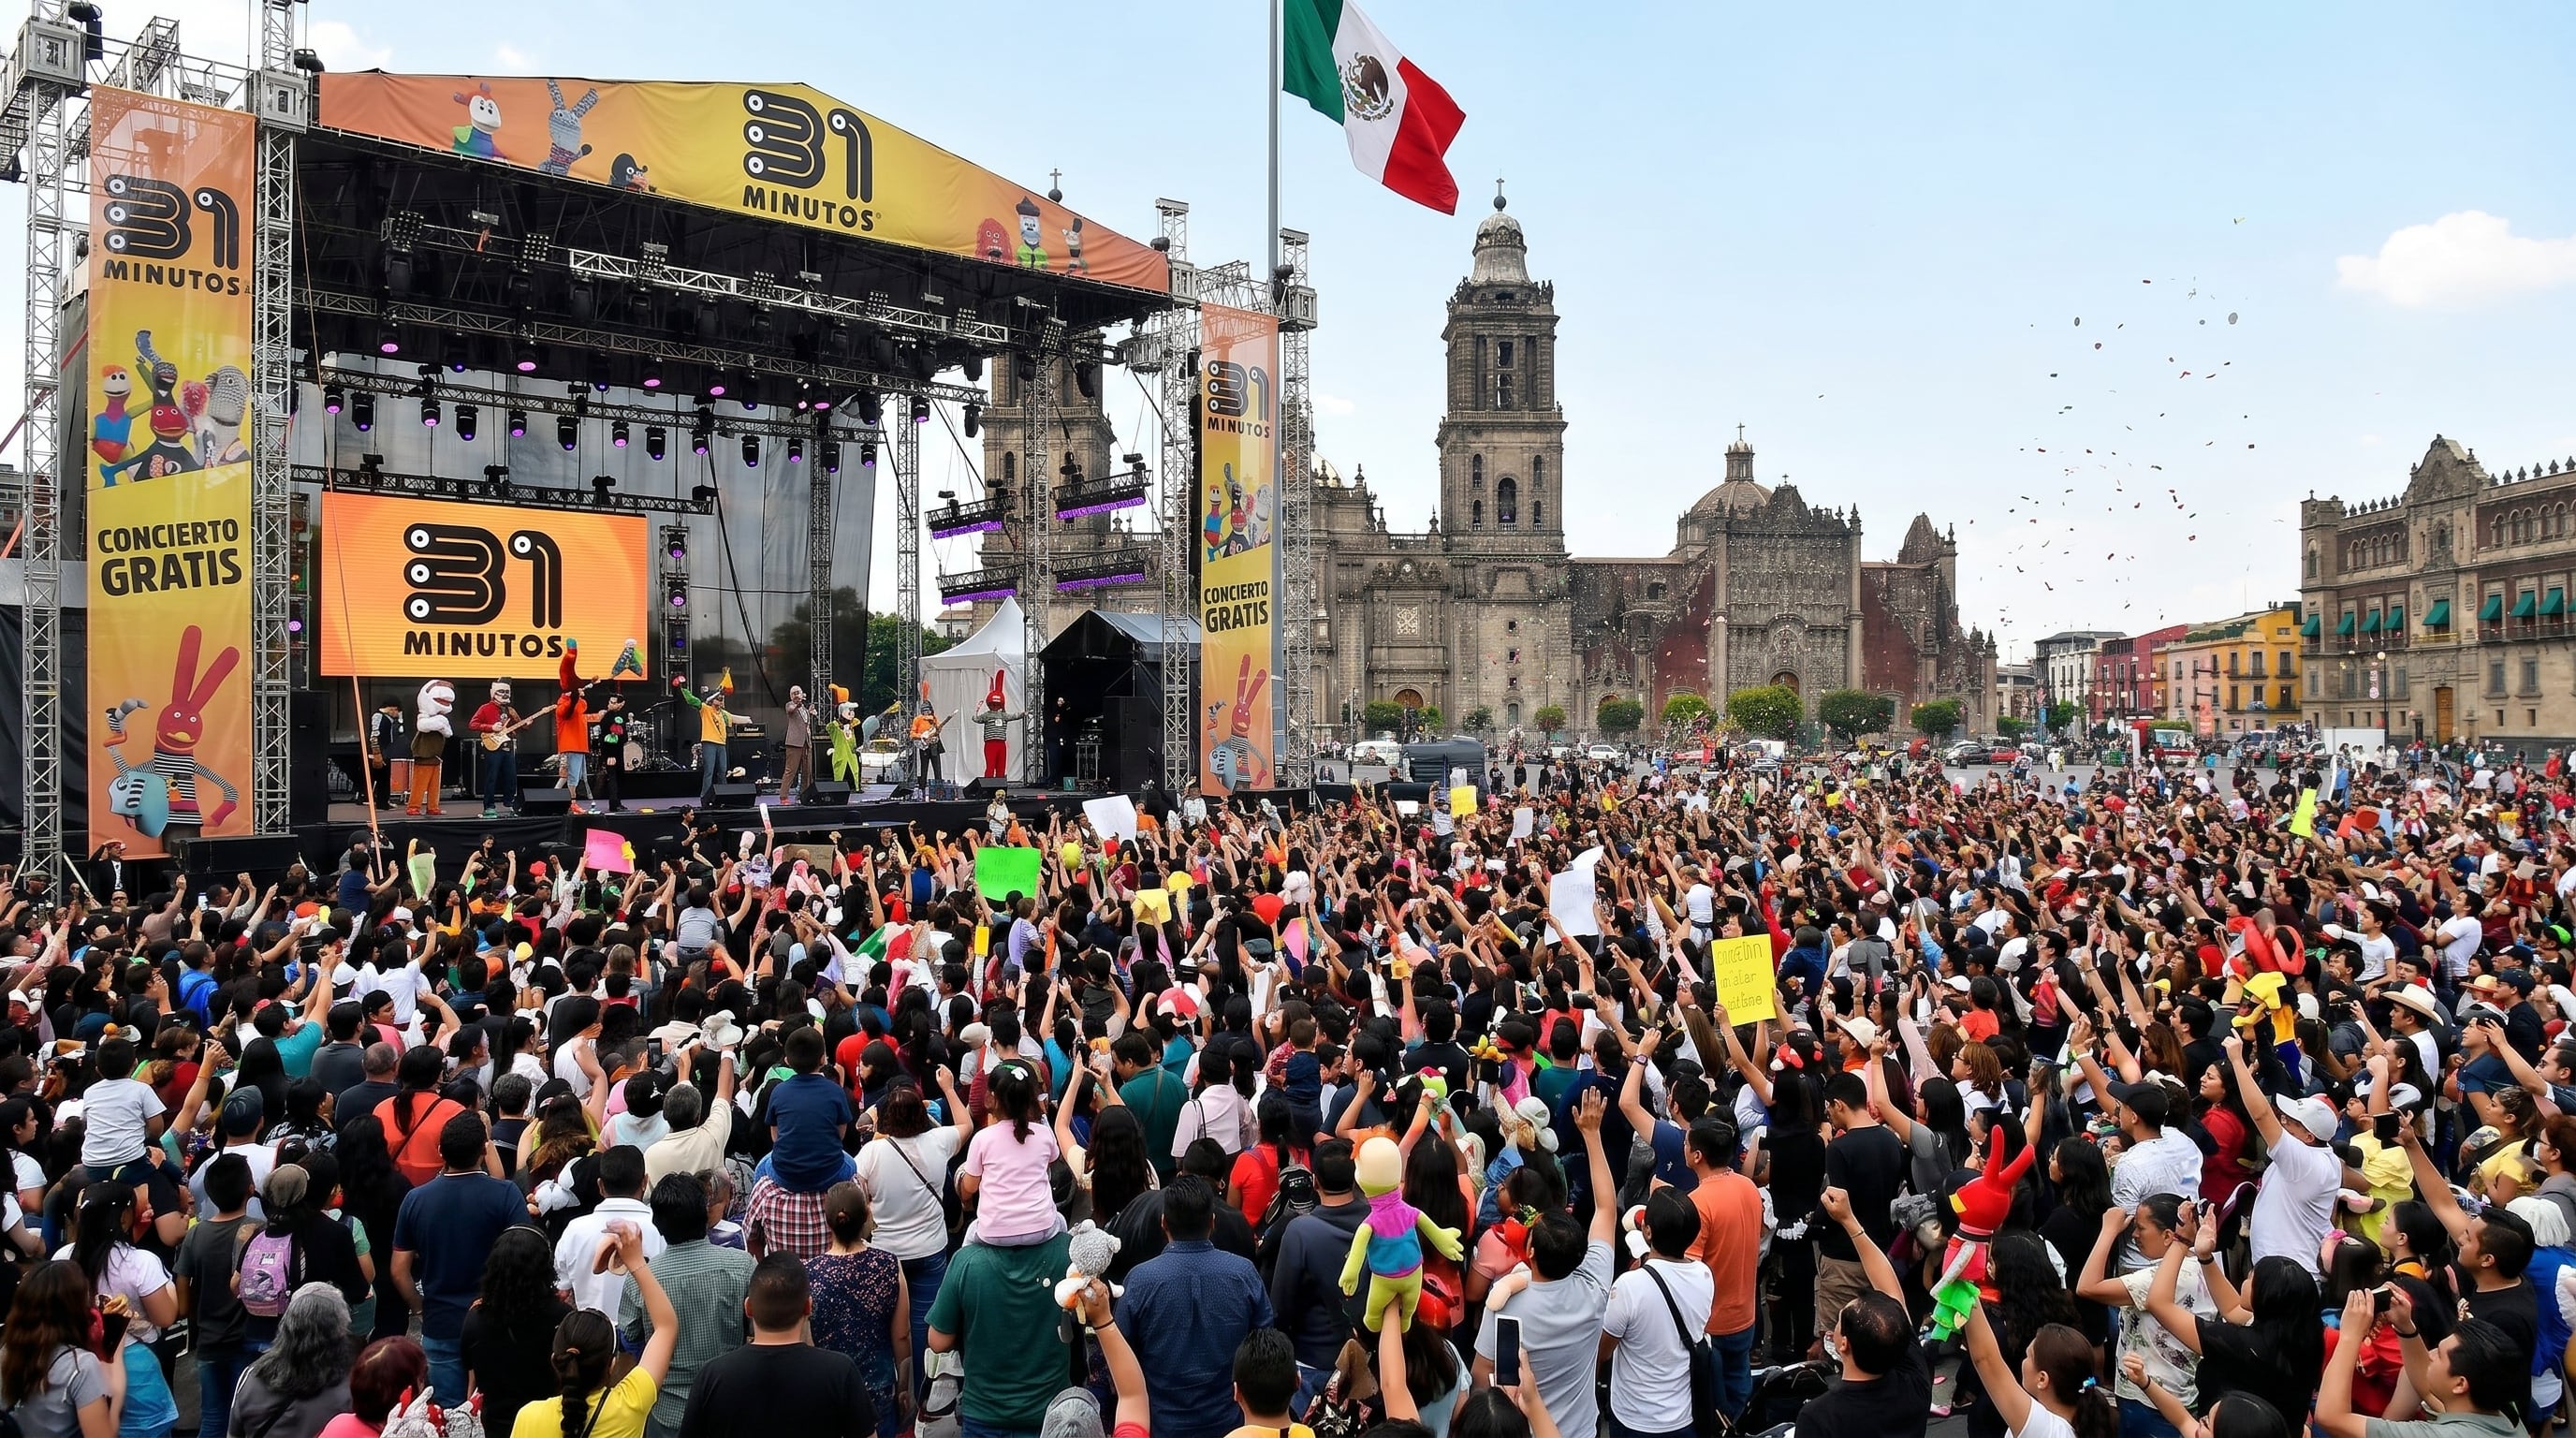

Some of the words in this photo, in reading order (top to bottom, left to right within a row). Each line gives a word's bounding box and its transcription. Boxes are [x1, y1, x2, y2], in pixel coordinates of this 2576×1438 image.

[743, 89, 873, 203] 31
[103, 174, 240, 271] 31
[743, 185, 874, 232] MINUTOS
[103, 259, 240, 296] MINUTOS
[1207, 360, 1269, 423] 31
[1208, 417, 1270, 439] MINUTOS
[97, 518, 240, 554] CONCIERTO
[101, 548, 242, 597] GRATIS
[403, 522, 563, 630] 31
[1204, 580, 1268, 605] CONCIERTO
[1205, 600, 1269, 634] GRATIS
[403, 630, 564, 658] MINUTOS
